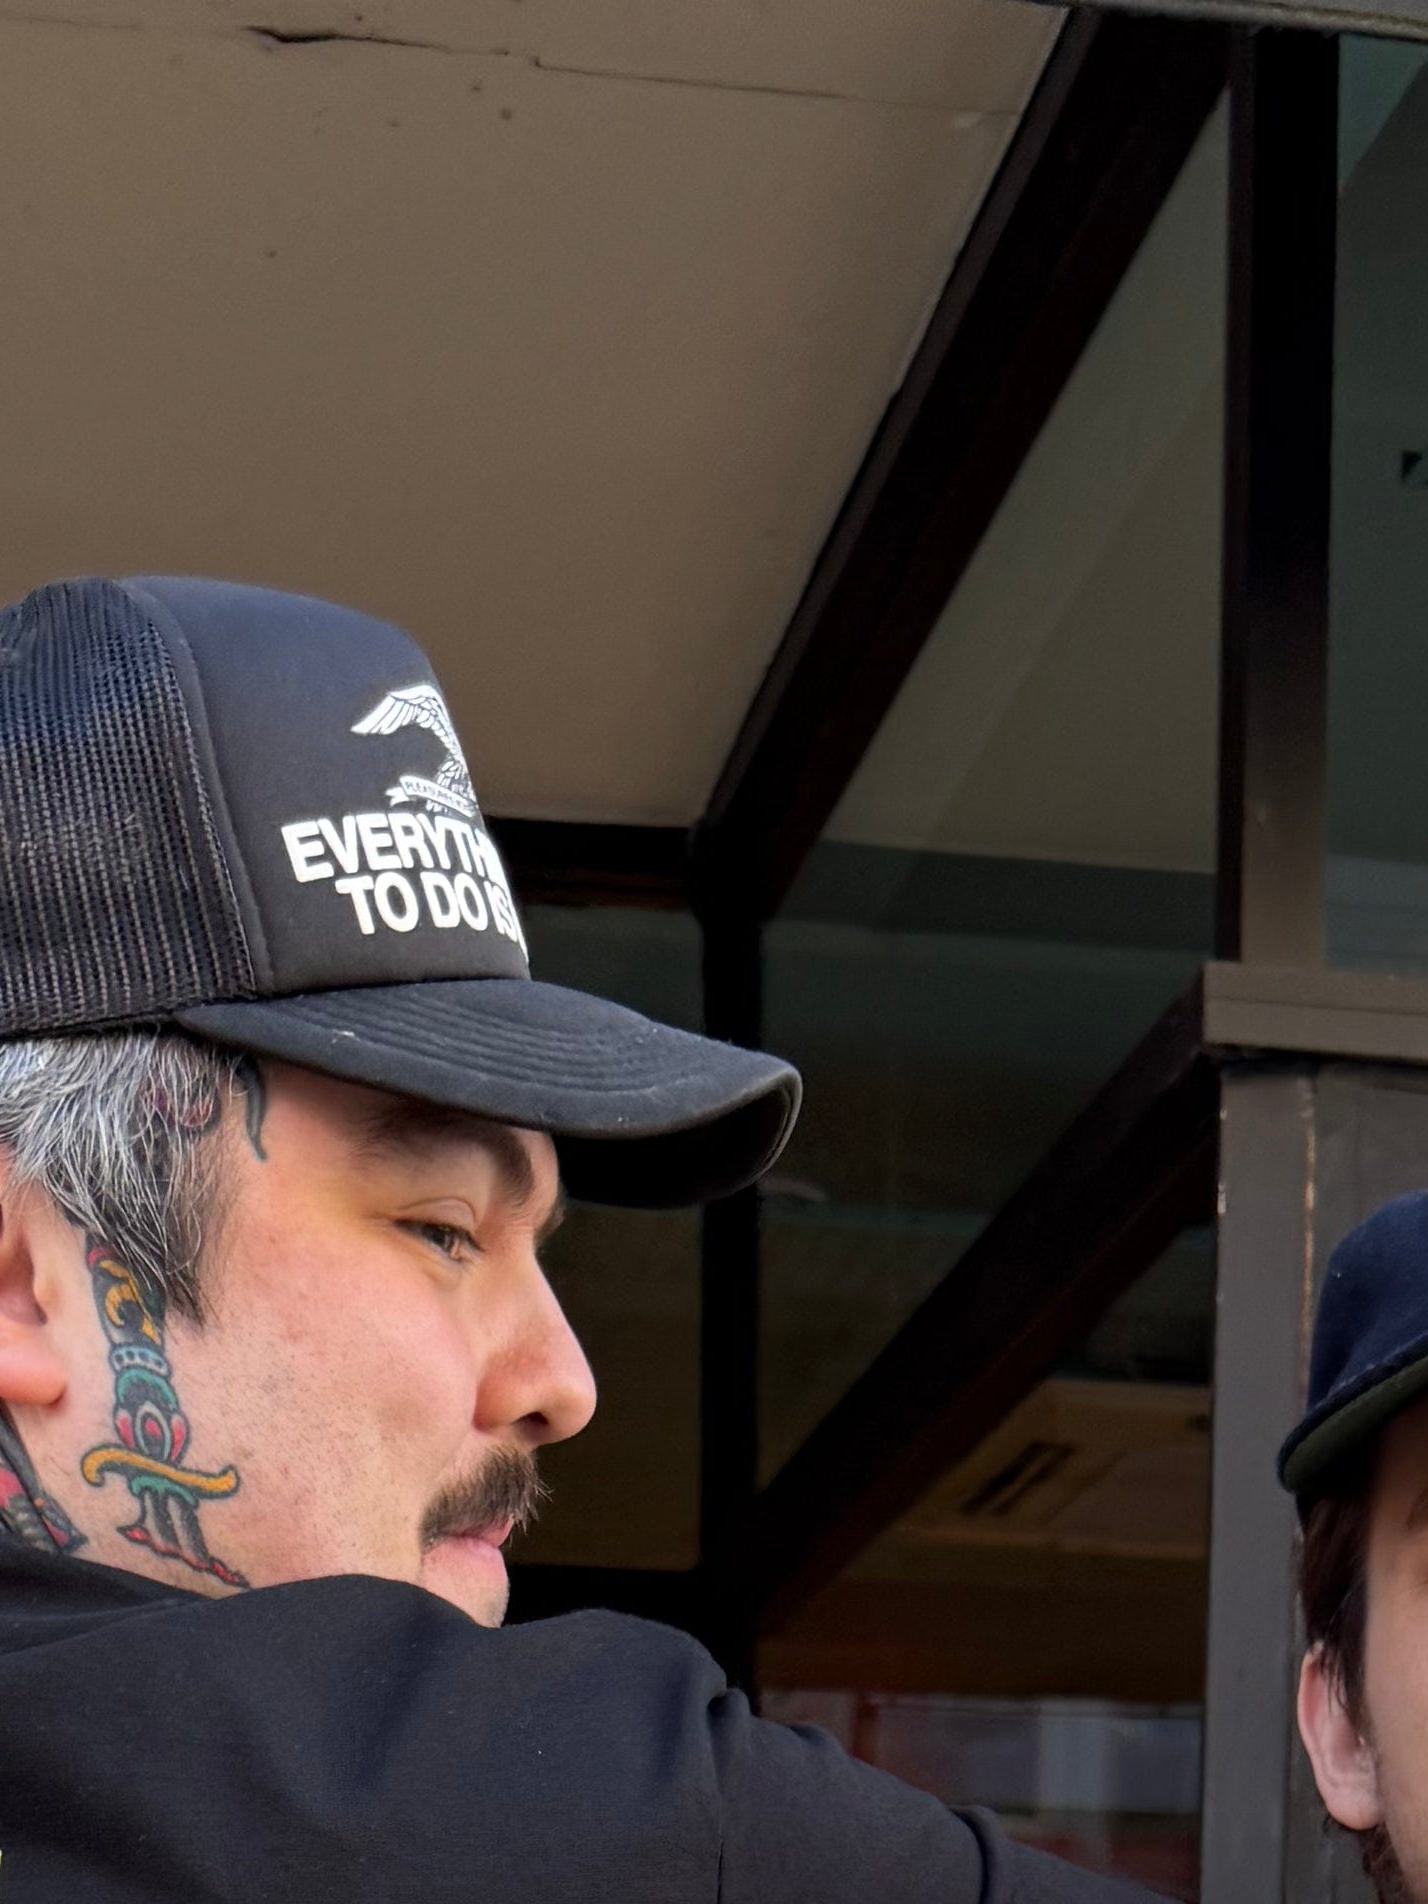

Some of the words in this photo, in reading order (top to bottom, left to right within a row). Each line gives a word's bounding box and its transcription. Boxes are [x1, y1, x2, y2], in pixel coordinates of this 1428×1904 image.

[281, 811, 510, 888] EVERYTH
[335, 871, 419, 934] TO
[419, 871, 489, 932] DO
